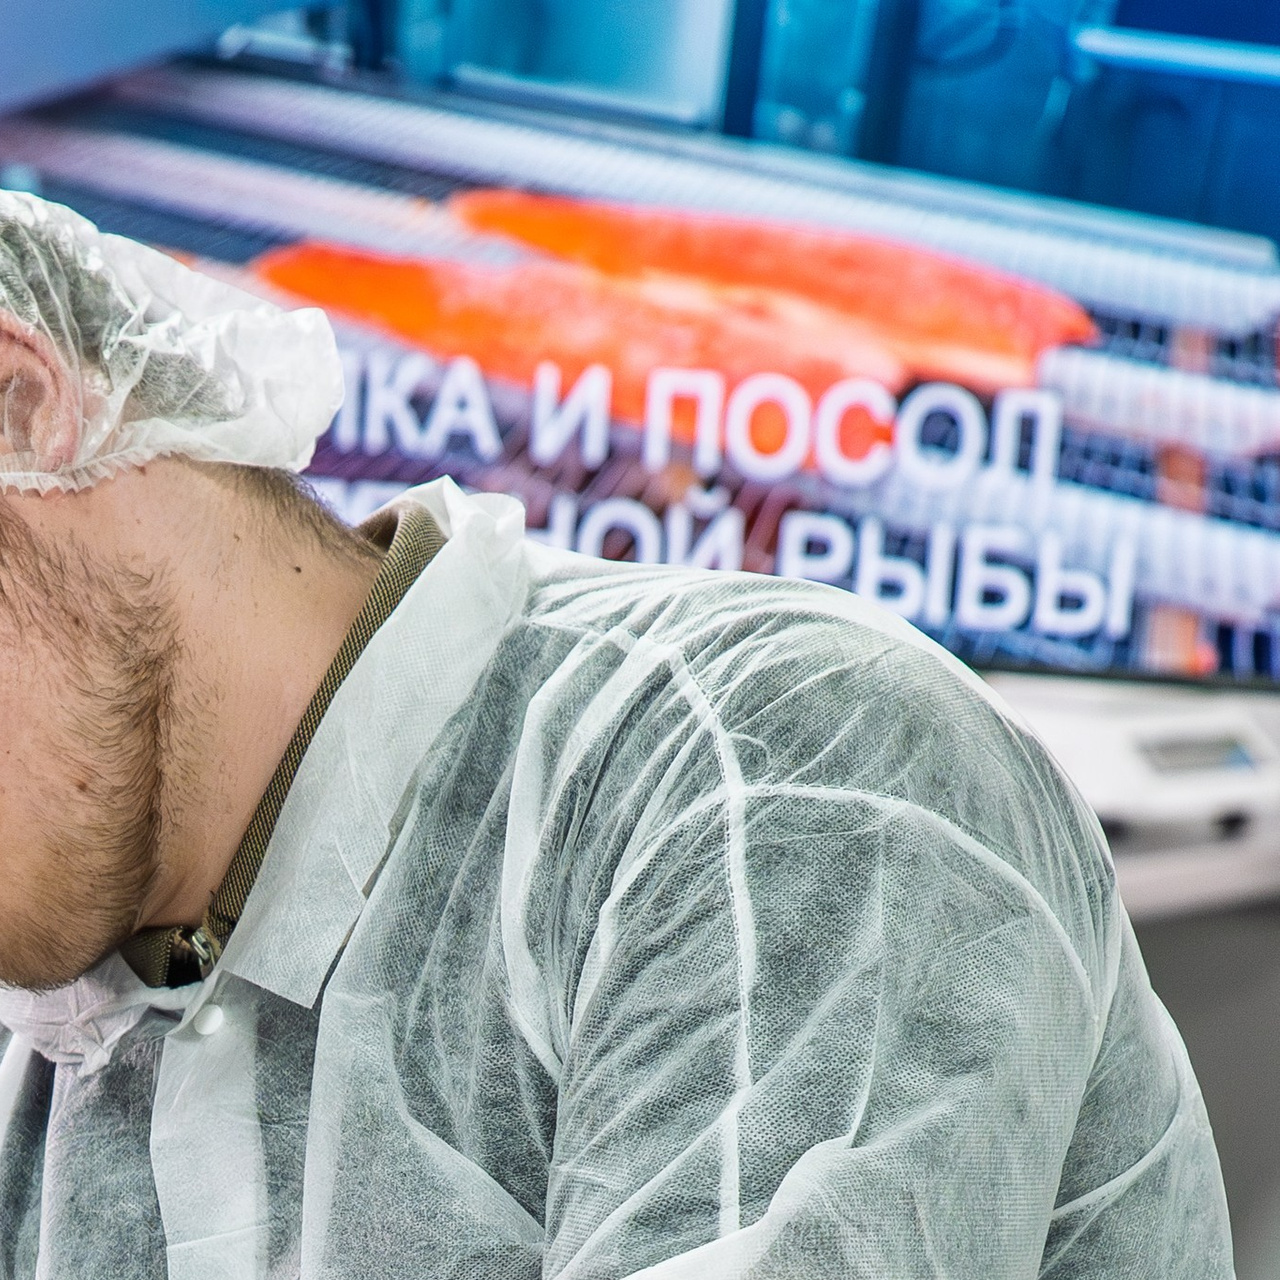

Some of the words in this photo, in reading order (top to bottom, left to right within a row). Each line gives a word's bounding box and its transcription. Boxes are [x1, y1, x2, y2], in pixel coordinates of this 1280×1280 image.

[527, 360, 612, 468] И
[643, 368, 1062, 492] ПОСОЛ
[776, 508, 1136, 642] РЫБЫ
